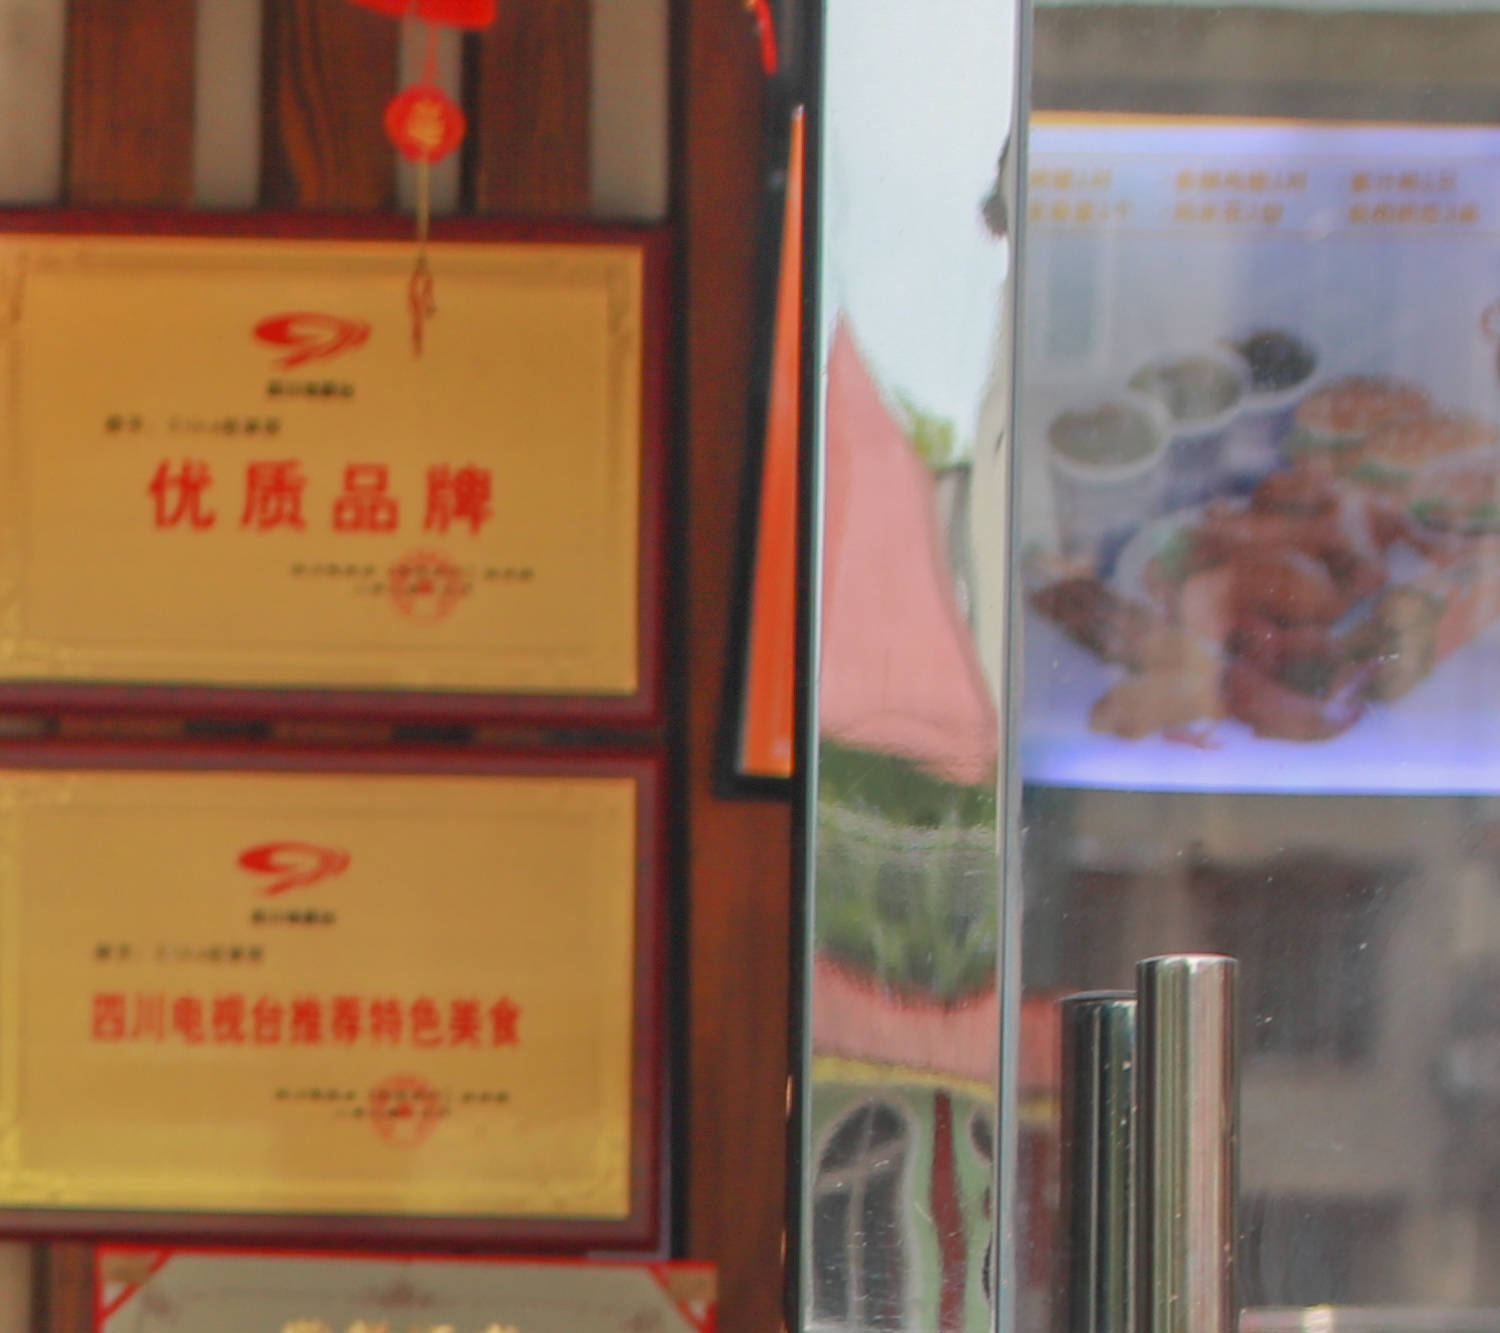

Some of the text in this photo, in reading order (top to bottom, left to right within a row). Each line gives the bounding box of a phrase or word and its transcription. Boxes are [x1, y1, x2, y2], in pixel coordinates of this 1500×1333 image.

[147, 457, 497, 536] 优质品牌
[91, 991, 522, 1049] 四川电视台推荐特色美食
